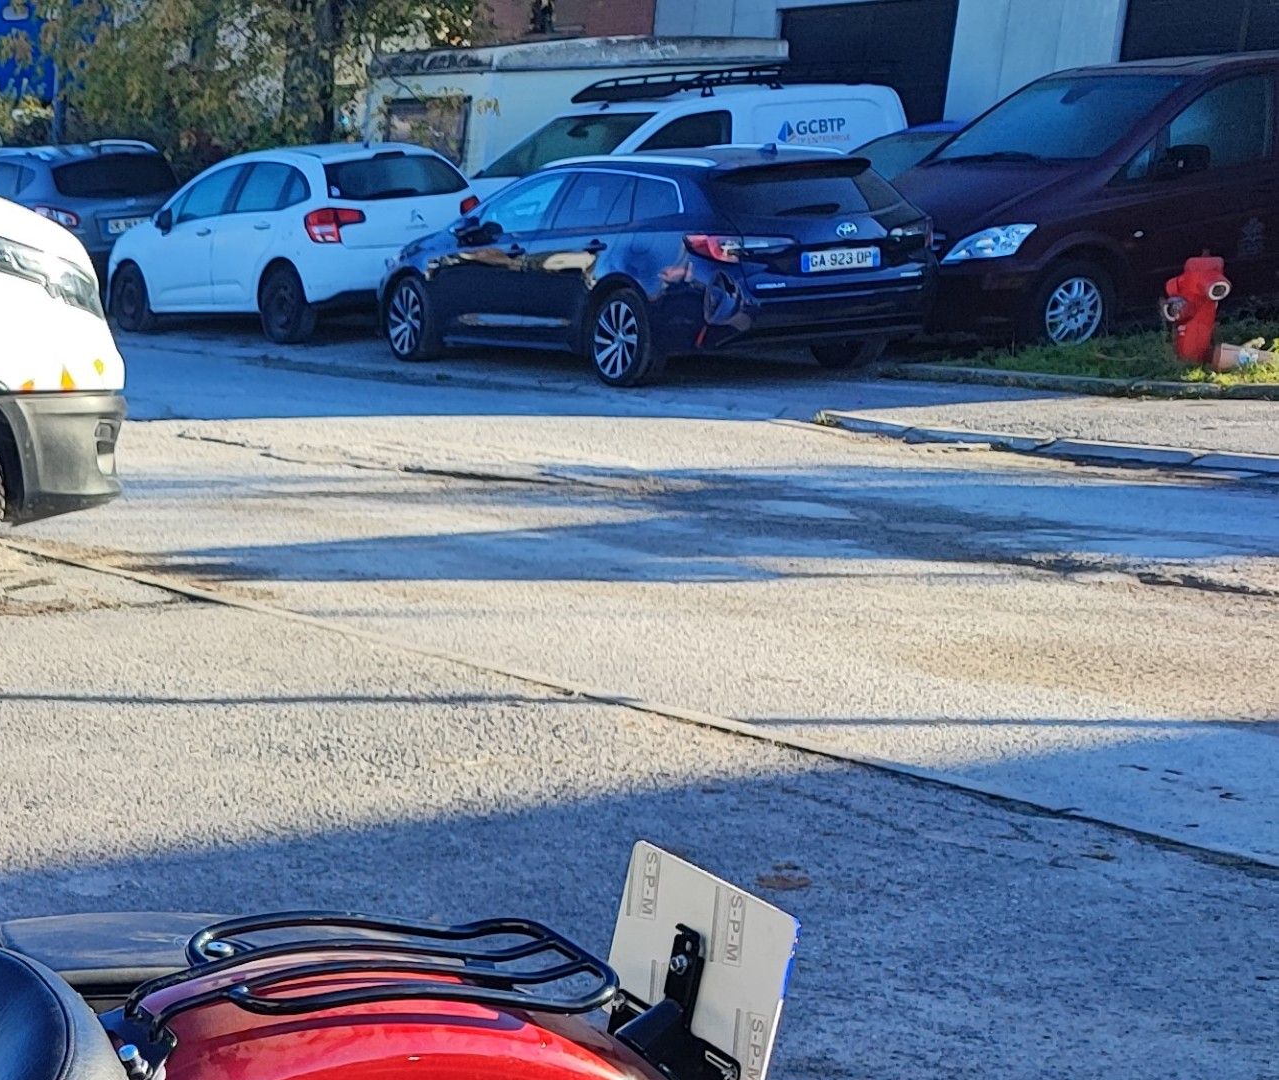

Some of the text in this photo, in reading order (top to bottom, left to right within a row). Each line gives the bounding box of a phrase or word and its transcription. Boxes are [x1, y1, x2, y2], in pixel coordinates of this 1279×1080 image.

[796, 117, 846, 135] GCBTP
[641, 851, 658, 917] S-P-M
[726, 894, 743, 962] S-P-M
